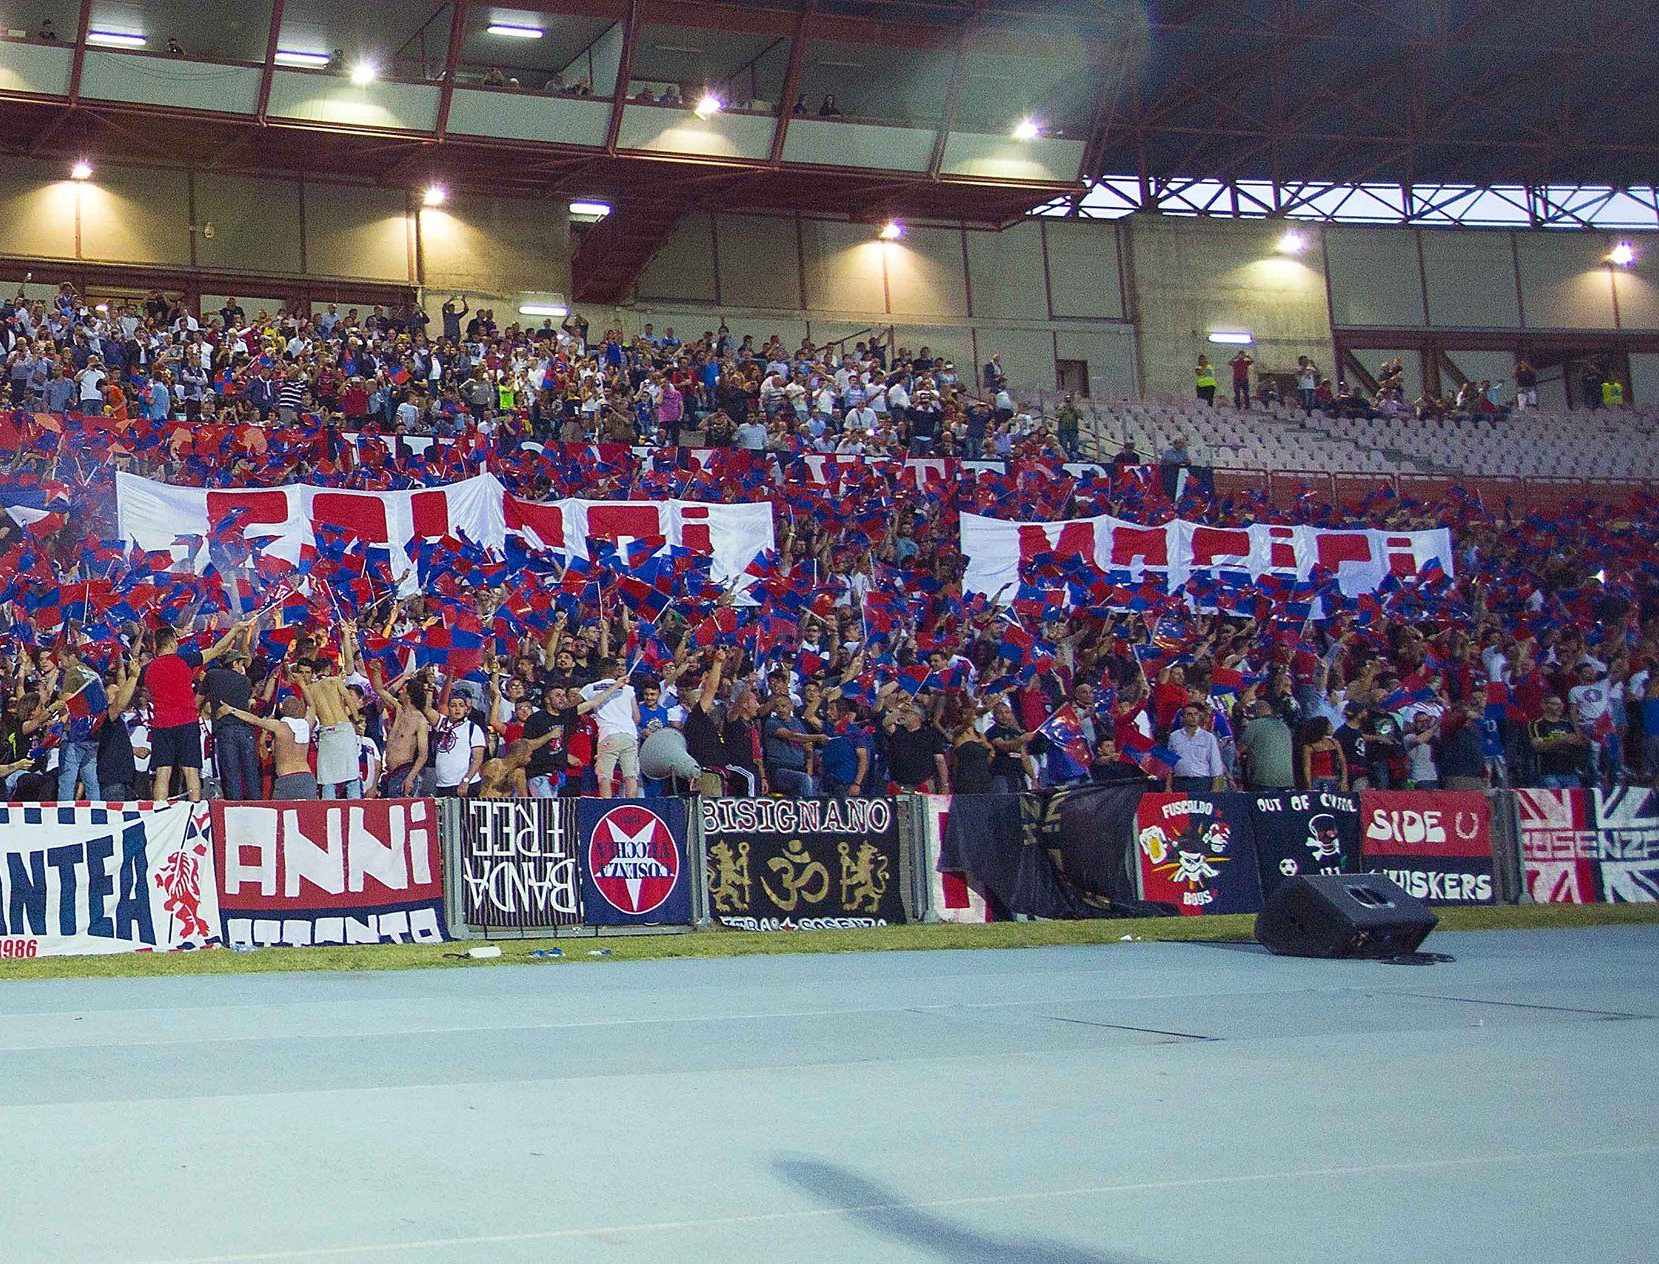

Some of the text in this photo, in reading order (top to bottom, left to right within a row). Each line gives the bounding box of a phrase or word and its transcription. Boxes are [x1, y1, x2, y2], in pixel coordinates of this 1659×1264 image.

[703, 799, 892, 835] BISIGNANO
[1257, 798, 1283, 812] OUT
[1291, 794, 1310, 811] OF
[471, 800, 565, 858] FREE
[1366, 809, 1446, 843] SIDE
[596, 841, 672, 860] VECCHIA
[464, 857, 577, 914] BANDA
[1183, 890, 1213, 906] BOYS
